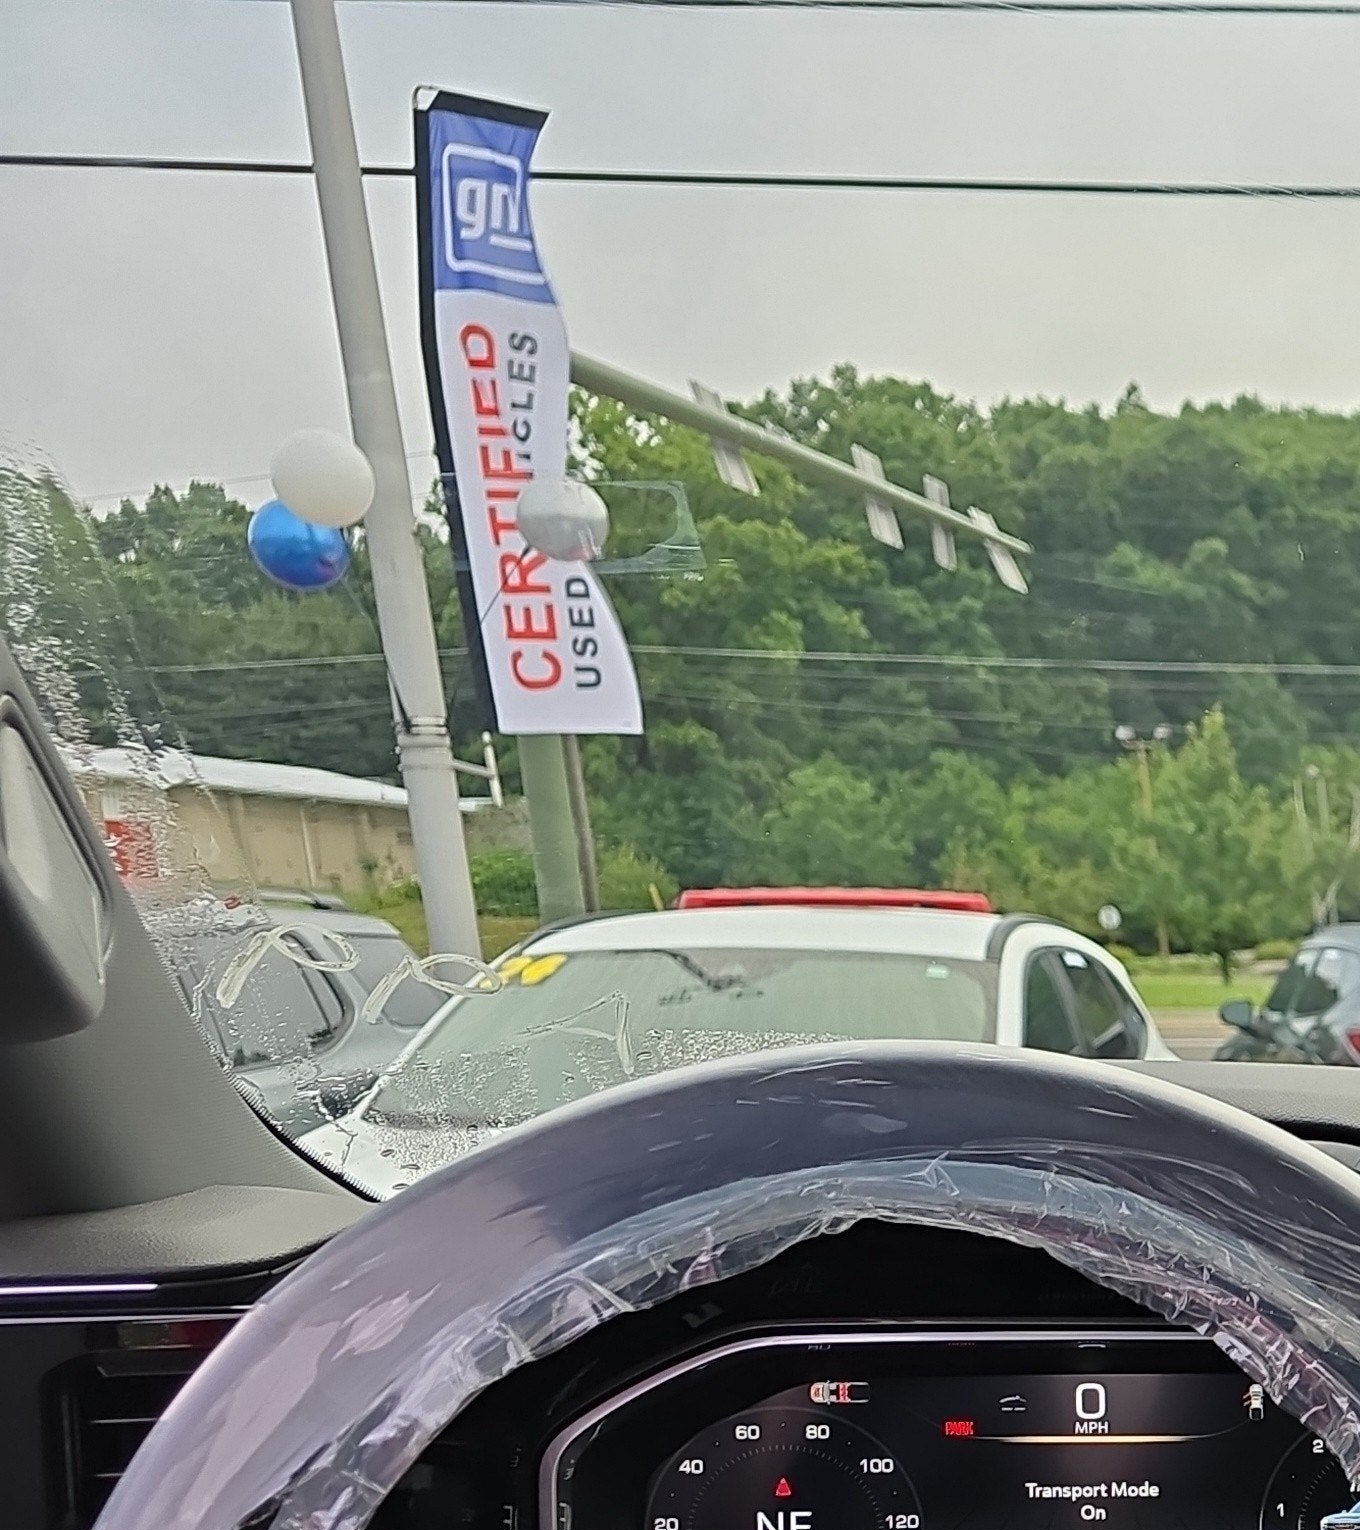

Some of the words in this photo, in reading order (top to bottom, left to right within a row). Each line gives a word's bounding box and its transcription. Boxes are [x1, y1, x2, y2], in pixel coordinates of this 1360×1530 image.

[460, 324, 562, 690] CERTIFIED
[565, 577, 602, 689] USED
[1075, 1383, 1106, 1419] 0
[735, 1425, 760, 1440] 60
[805, 1425, 830, 1440] 80
[1074, 1422, 1109, 1434] MPH
[1312, 1439, 1325, 1454] 2
[679, 1459, 704, 1475] 40
[859, 1458, 894, 1474] 100
[1025, 1483, 1108, 1501] Transport
[1111, 1482, 1160, 1498] Mode
[1080, 1505, 1107, 1521] On
[1277, 1503, 1285, 1517] 1
[885, 1515, 920, 1530] 120
